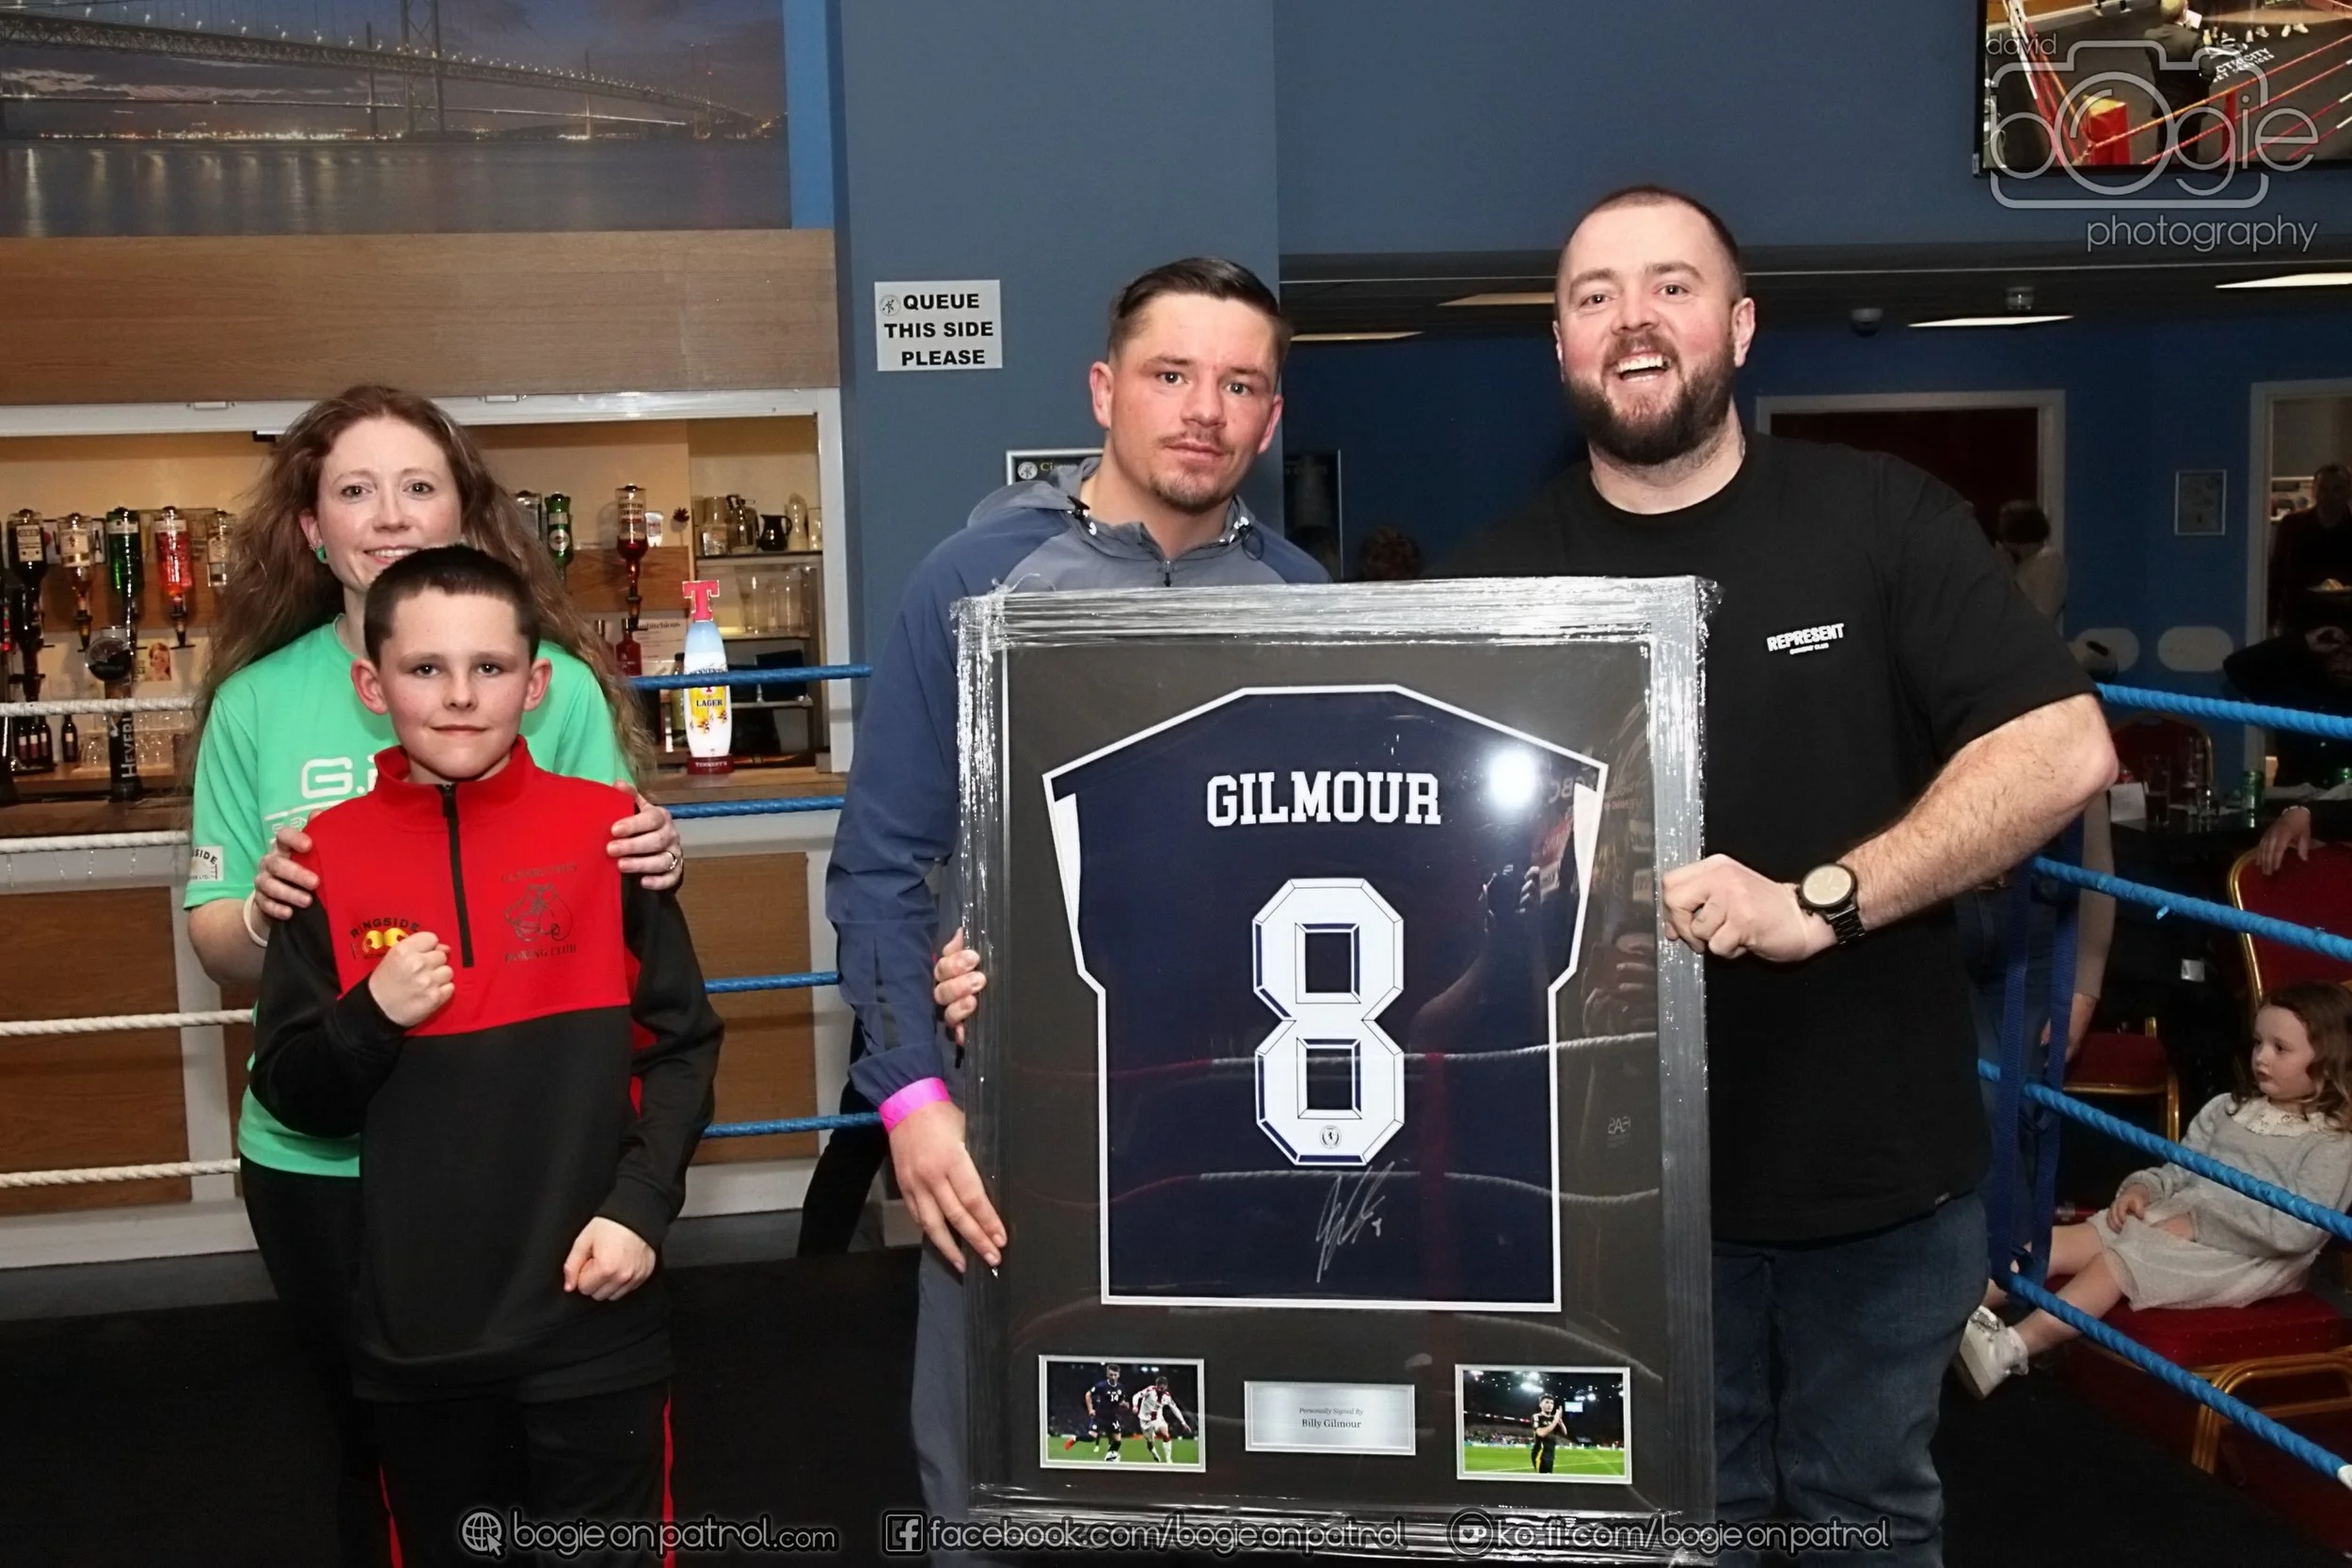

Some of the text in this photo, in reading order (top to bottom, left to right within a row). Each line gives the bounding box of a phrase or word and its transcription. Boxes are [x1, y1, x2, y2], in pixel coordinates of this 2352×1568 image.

[903, 293, 979, 310] QUEUE
[883, 321, 993, 338] THIS SIDE
[901, 349, 985, 366] PLEASE
[1767, 623, 1845, 652] REPRESENT
[696, 699, 723, 707] LAGER
[1207, 770, 1441, 828] GILMOUR
[191, 848, 217, 864] SIDE
[350, 917, 420, 939] RINGSIDE
[1252, 878, 1405, 1166] 8
[1332, 1407, 1354, 1416] Signed
[1302, 1418, 1362, 1429] Billy Gilmour
